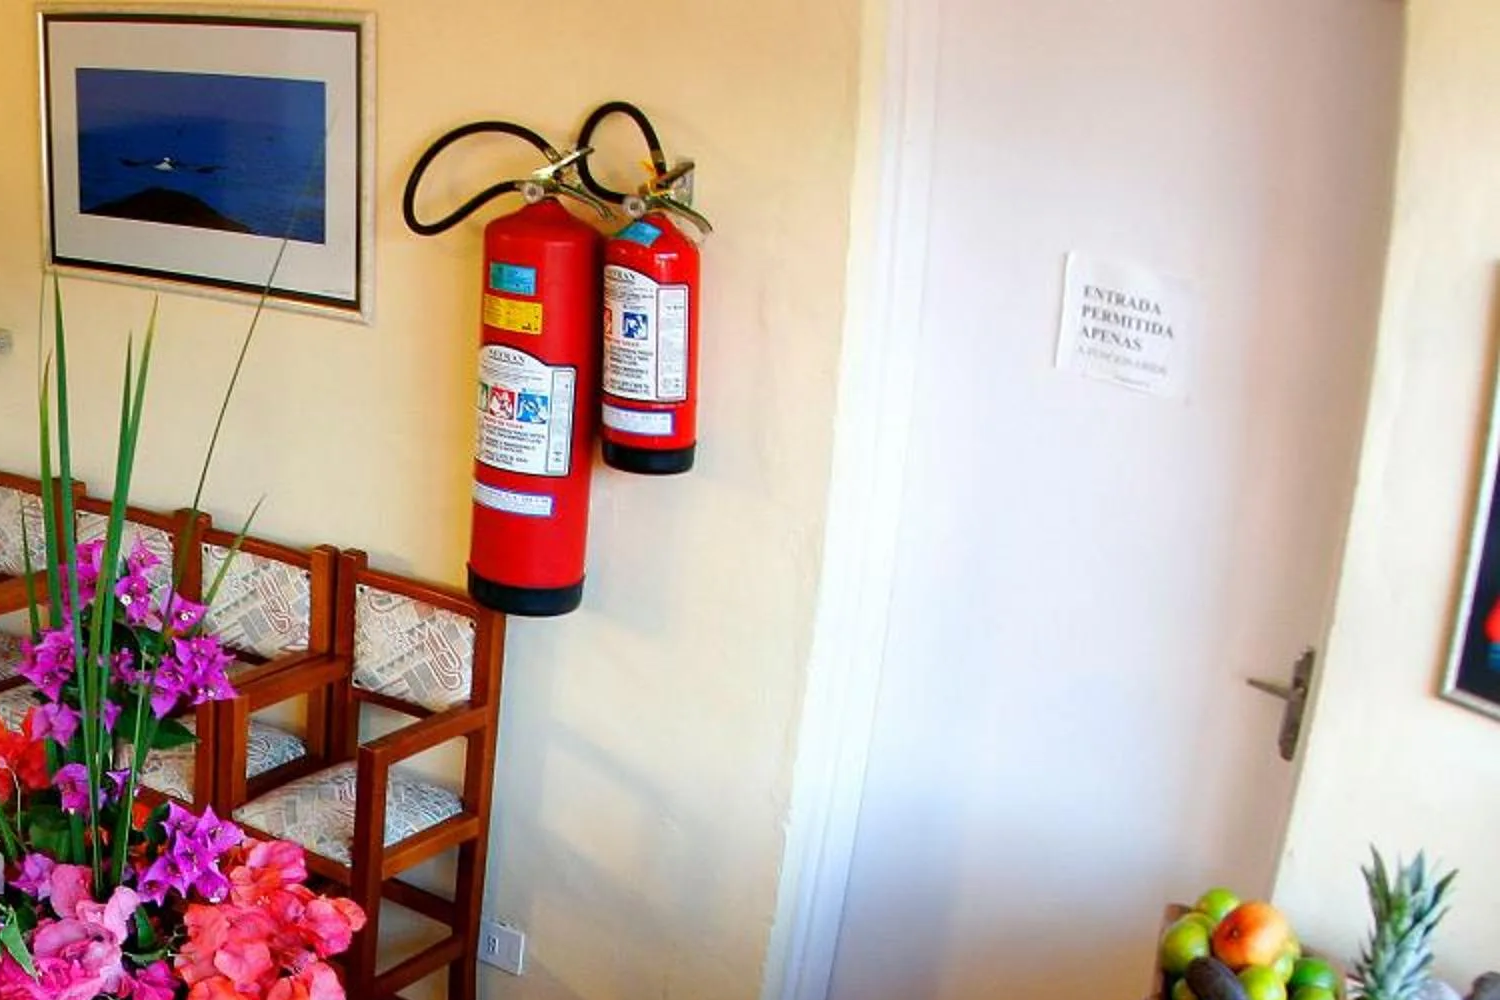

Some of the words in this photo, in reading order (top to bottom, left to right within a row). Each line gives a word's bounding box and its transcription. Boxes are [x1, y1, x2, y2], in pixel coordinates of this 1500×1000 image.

[1083, 284, 1161, 316] ENTRADA
[1081, 304, 1173, 340] PERMITIDA
[1080, 325, 1142, 352] APENAS
